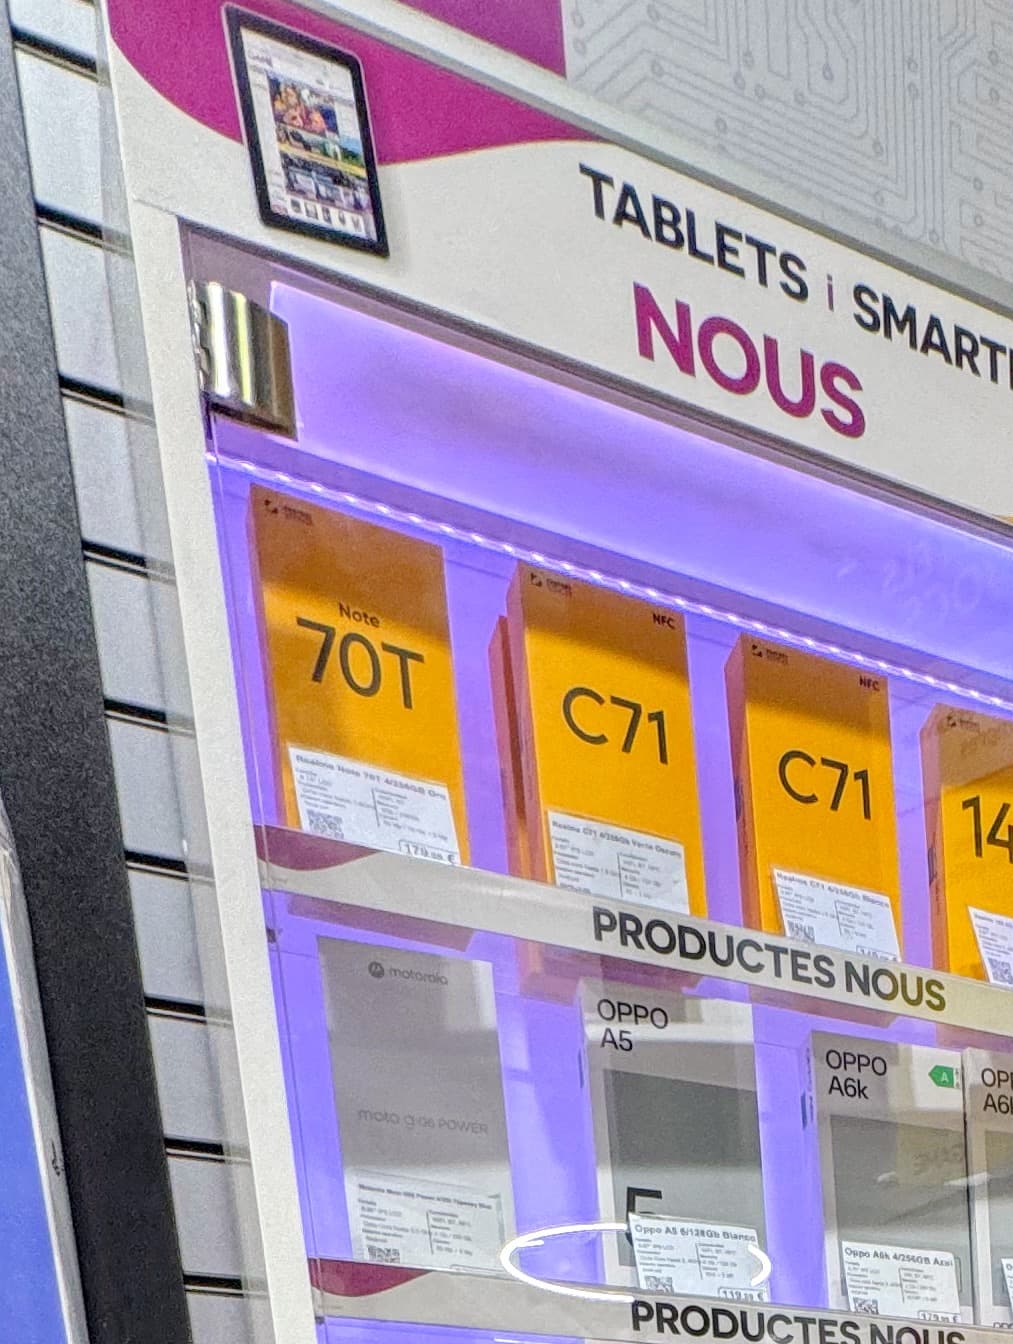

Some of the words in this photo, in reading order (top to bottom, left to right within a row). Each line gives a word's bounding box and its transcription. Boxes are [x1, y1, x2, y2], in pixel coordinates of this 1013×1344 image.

[579, 163, 809, 304] TABLETS
[633, 281, 867, 439] NOUS
[339, 602, 381, 628] Note
[652, 612, 676, 630] NFC
[296, 616, 425, 710] 70T
[859, 675, 880, 692] NFC
[562, 686, 668, 765] C71
[778, 750, 872, 821] C71
[592, 904, 836, 989] PRODUCTES
[845, 960, 946, 1012] NOUS
[390, 965, 448, 986] motorola
[598, 998, 669, 1030] OPPO
[600, 1027, 634, 1053] A5
[825, 1050, 887, 1076] OPPO
[828, 1077, 868, 1101] A6k
[439, 1117, 489, 1136] POWER
[631, 1300, 860, 1344] PRODUCTES
